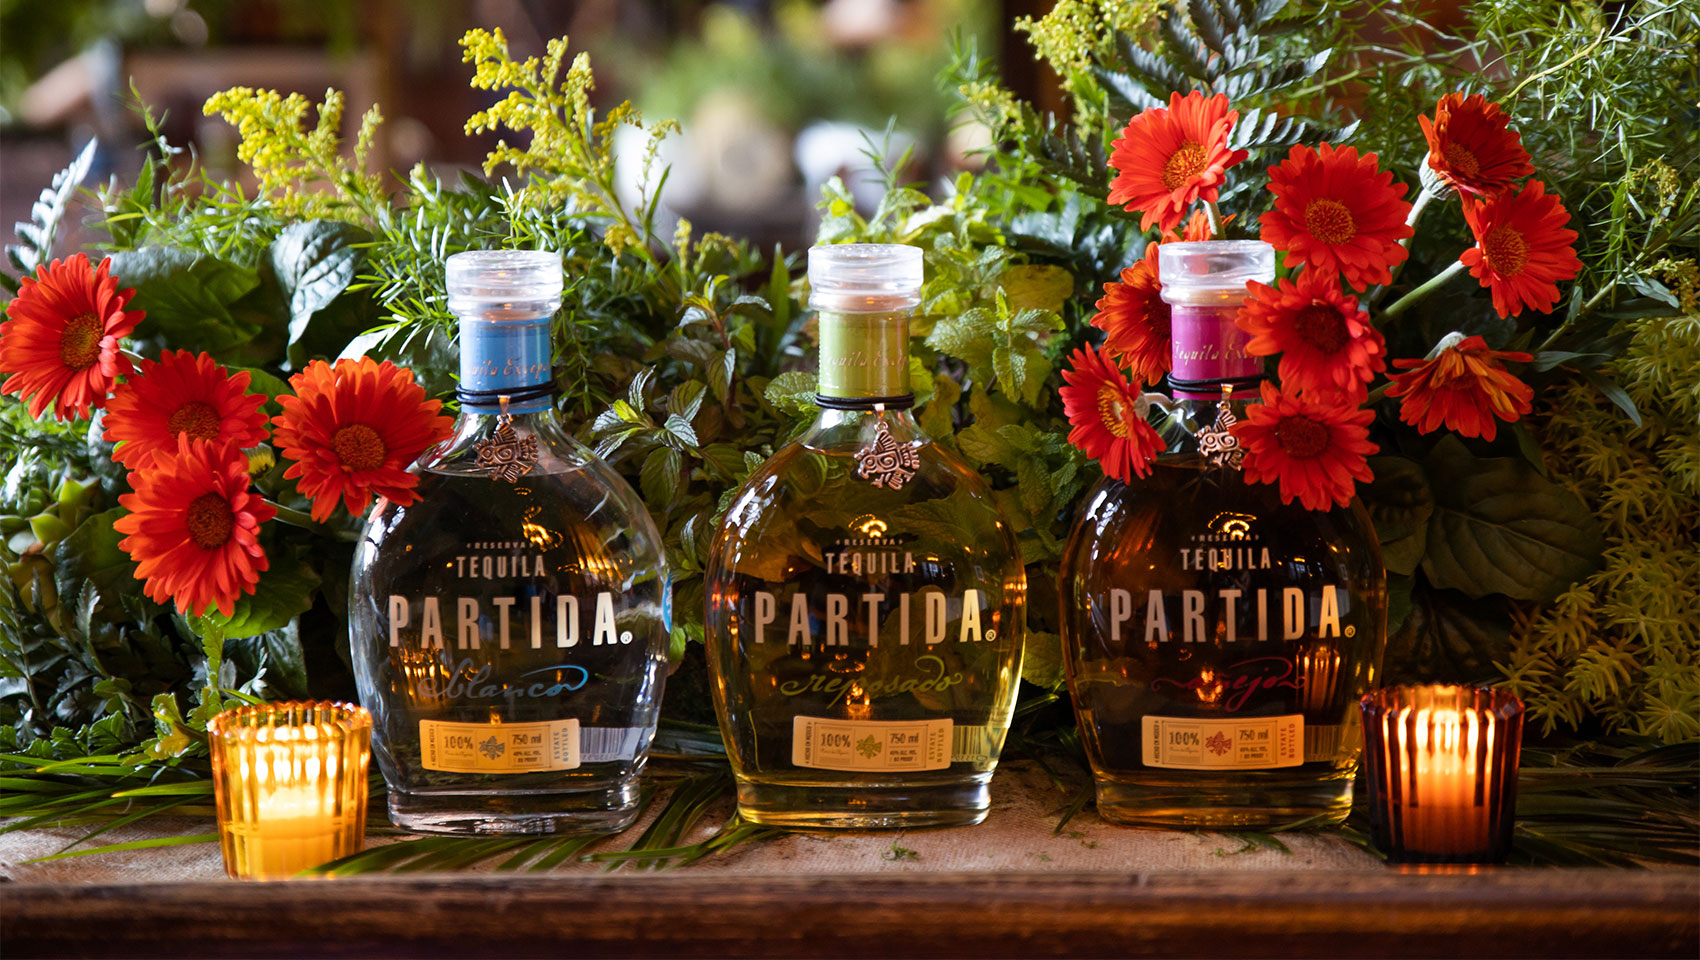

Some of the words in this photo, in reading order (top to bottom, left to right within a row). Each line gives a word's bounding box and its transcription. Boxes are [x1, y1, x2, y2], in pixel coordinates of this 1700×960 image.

[1173, 340, 1220, 366] Tequila
[474, 541, 526, 550] RESERVA
[844, 538, 896, 546] RESERVA
[456, 554, 546, 579] TEQUILA
[825, 552, 914, 576] TEQUILA
[1180, 547, 1271, 572] TEQUILA
[417, 657, 589, 699] blanco
[780, 655, 963, 710] reposado
[512, 734, 528, 745] 750
[531, 733, 541, 744] ml
[821, 733, 851, 748] 100%
[890, 733, 905, 744] 750
[908, 732, 919, 743] ml
[1169, 731, 1200, 746] 100%
[1240, 730, 1255, 740] 750
[1258, 729, 1268, 740] ml
[444, 735, 474, 750] 100%
[928, 732, 936, 760] ESTATE
